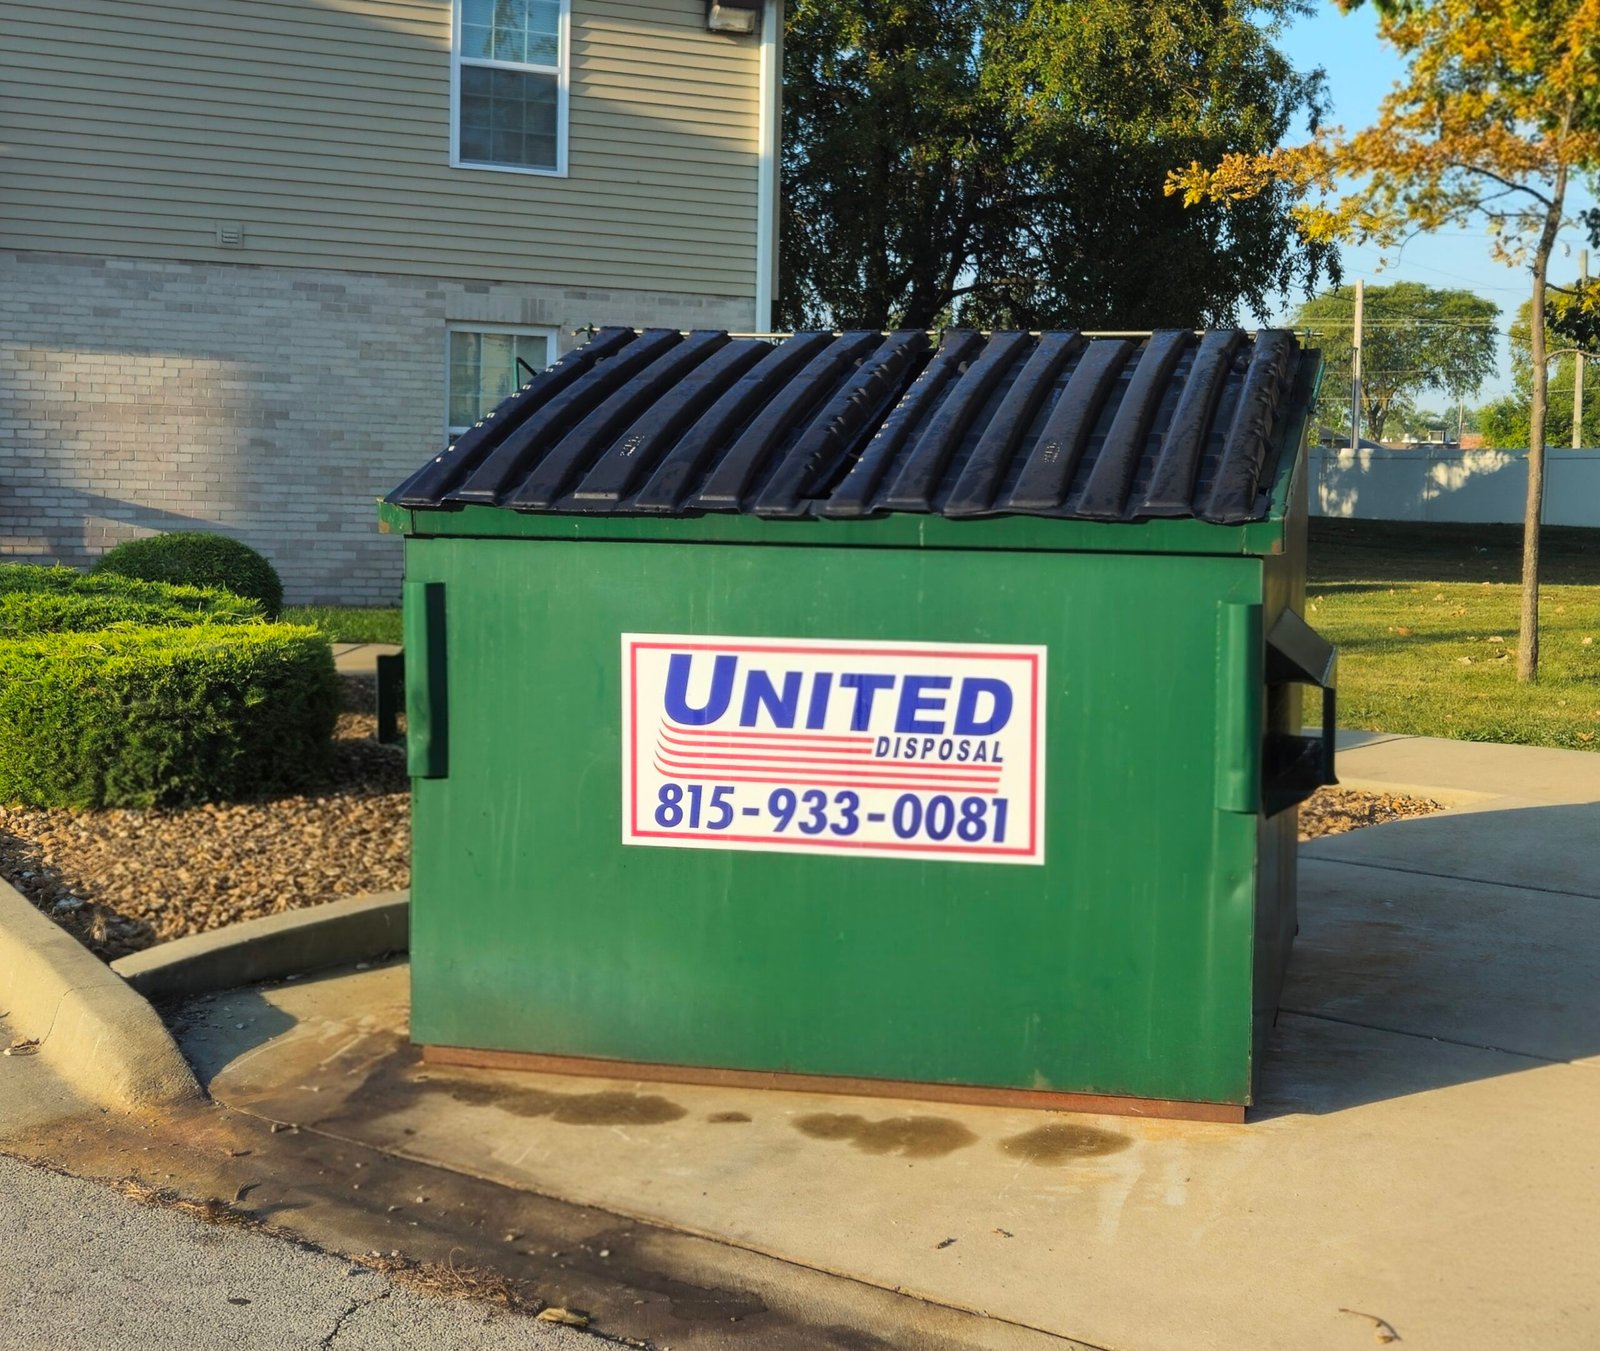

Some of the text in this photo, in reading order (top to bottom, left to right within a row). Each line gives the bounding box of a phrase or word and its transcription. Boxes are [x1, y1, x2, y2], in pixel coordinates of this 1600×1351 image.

[664, 653, 1014, 736] UNITED
[875, 735, 1004, 763] DISPOSAL
[654, 783, 1009, 843] 815-933-0081
